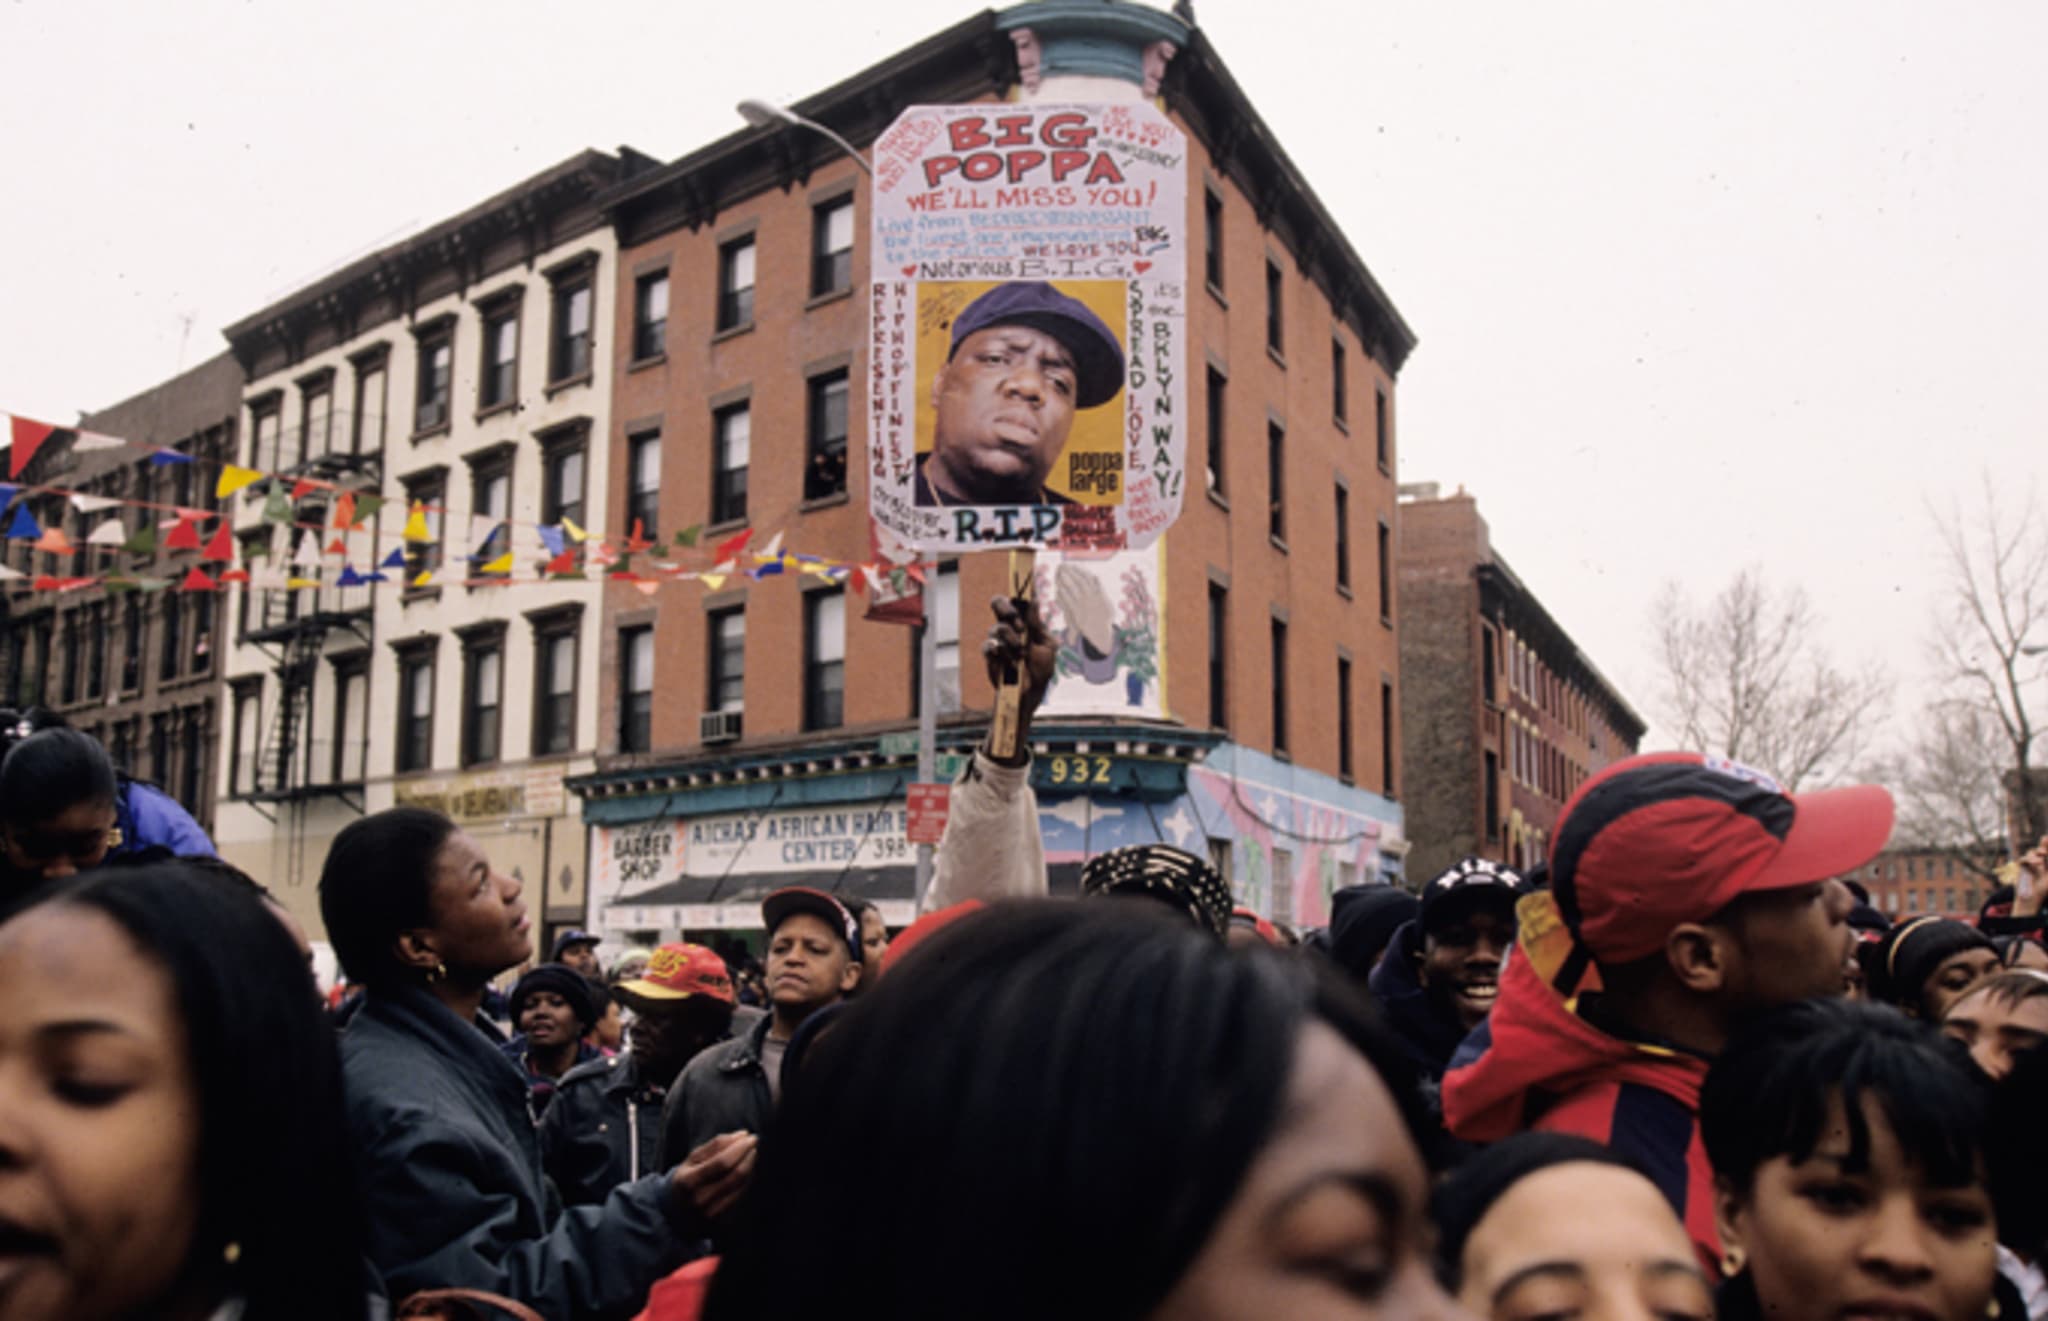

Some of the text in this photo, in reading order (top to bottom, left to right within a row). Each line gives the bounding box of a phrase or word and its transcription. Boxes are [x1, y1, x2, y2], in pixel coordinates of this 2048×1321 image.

[947, 113, 1097, 151] BIG
[922, 150, 1125, 188] POPPA
[907, 180, 1158, 211] WE'LL MISS YOU!
[1055, 243, 1101, 257] LOVE
[920, 260, 1014, 278] Notorious
[1129, 280, 1146, 389] SPREAD
[1153, 322, 1173, 416] BKLYN
[1069, 452, 1123, 473] poppa
[1069, 472, 1119, 495] large
[1051, 758, 1111, 783] 932
[766, 811, 849, 840] AFRICAN
[853, 809, 894, 836] HAIR
[613, 834, 672, 859] BARBER
[782, 838, 856, 864] CENTER
[619, 859, 661, 882] SHOP
